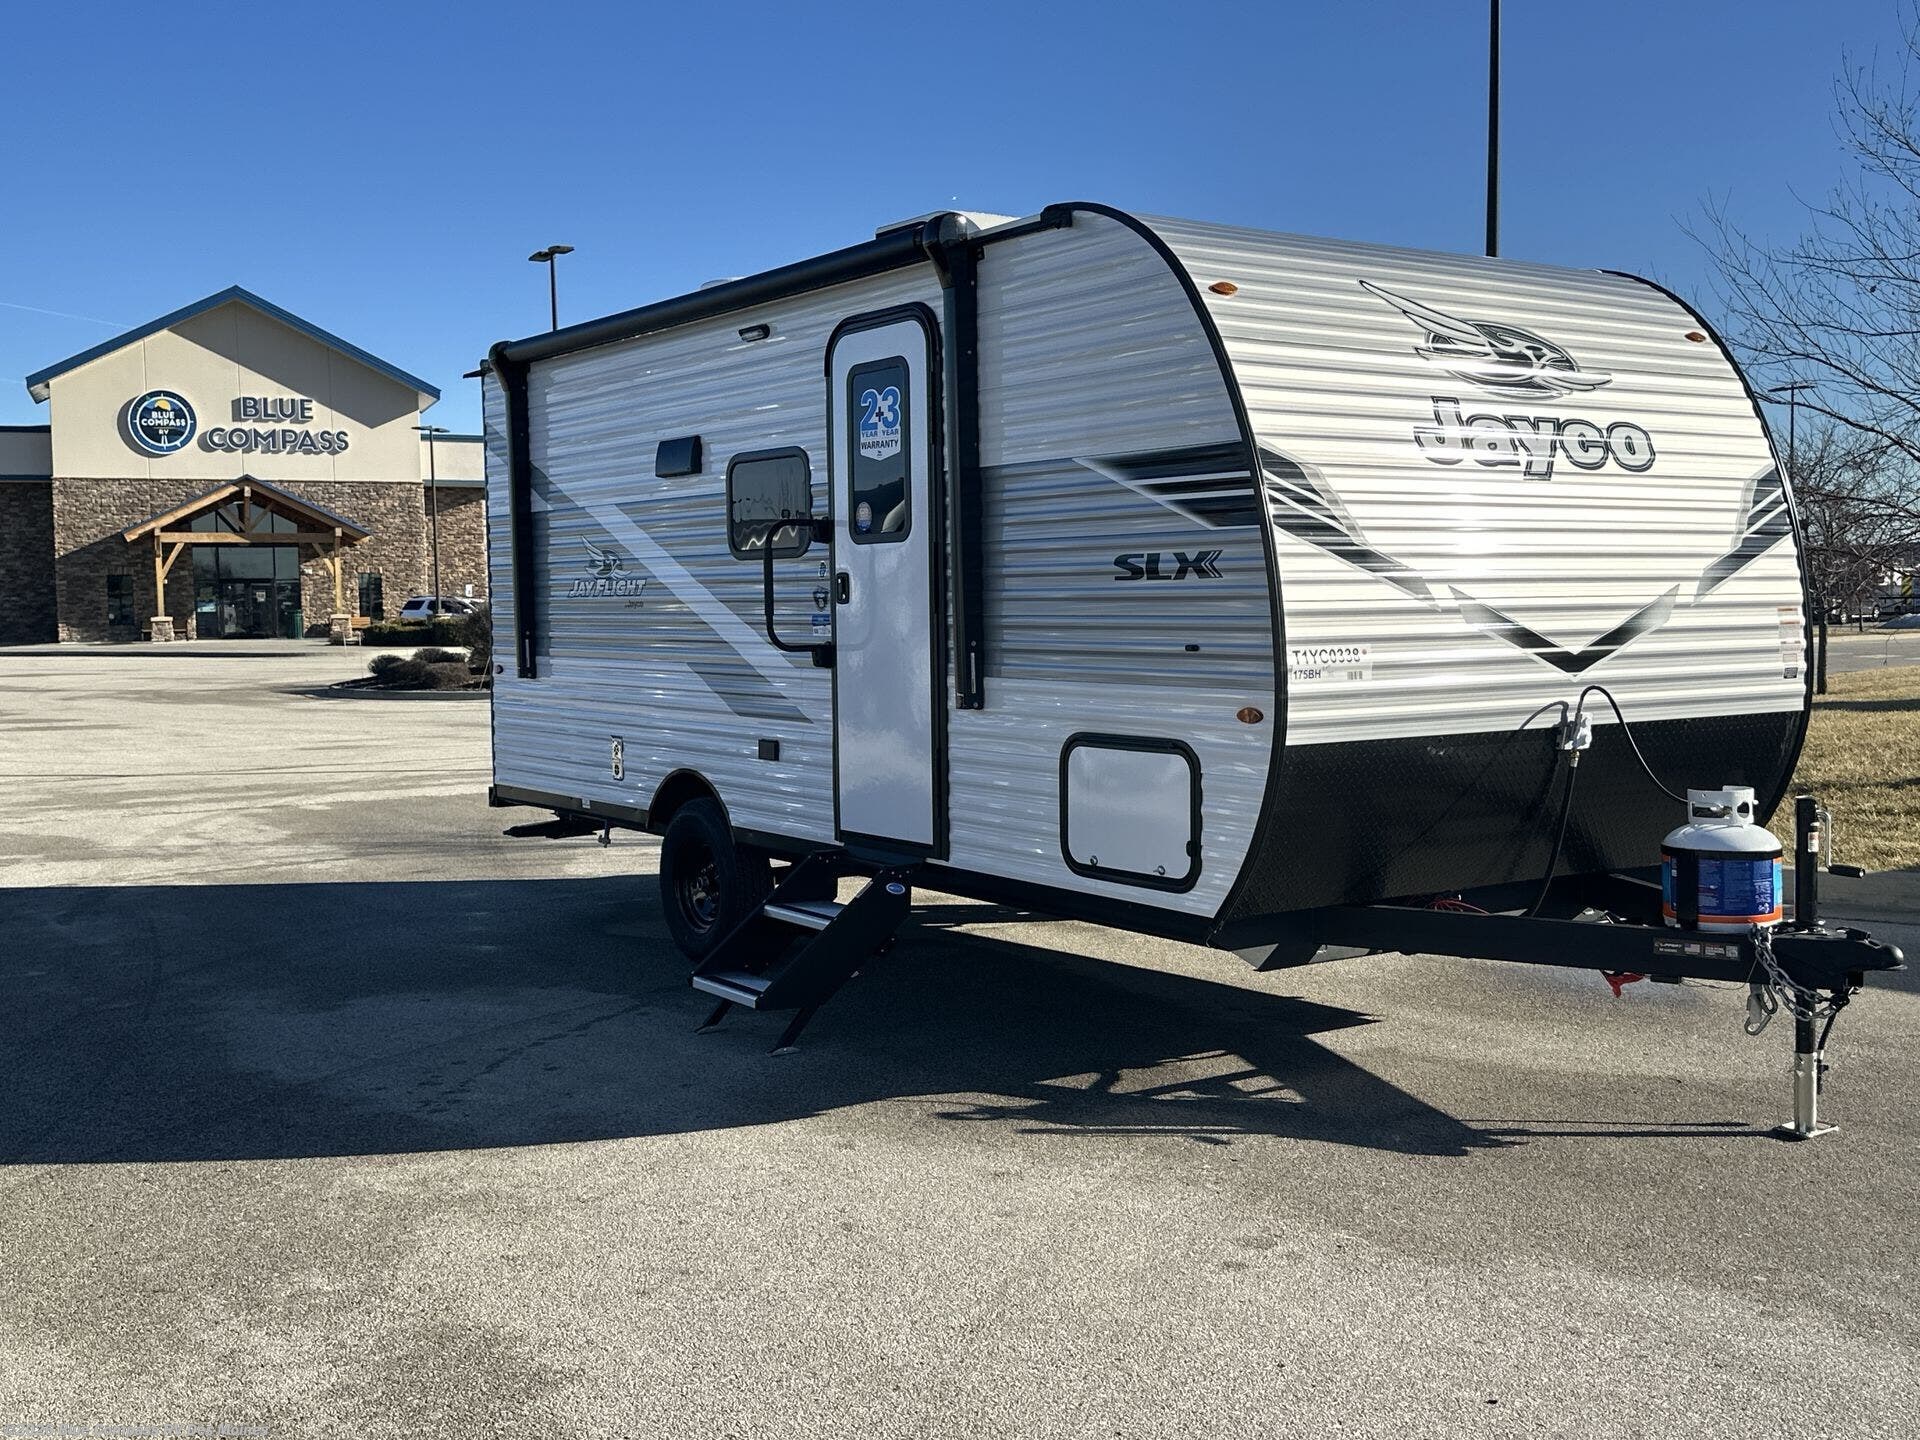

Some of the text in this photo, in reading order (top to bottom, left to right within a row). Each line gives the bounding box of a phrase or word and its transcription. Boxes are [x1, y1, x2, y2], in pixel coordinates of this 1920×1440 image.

[241, 396, 313, 420] BLUE
[151, 411, 175, 419] BLUE
[141, 418, 186, 427] COMPASS
[861, 428, 899, 438] YEAR YEAR
[1413, 396, 1655, 481] Jayco
[207, 427, 349, 452] COMPASS
[860, 439, 899, 450] WARRANTY
[1113, 550, 1223, 581] SLX
[1293, 669, 1322, 680] 175BH
